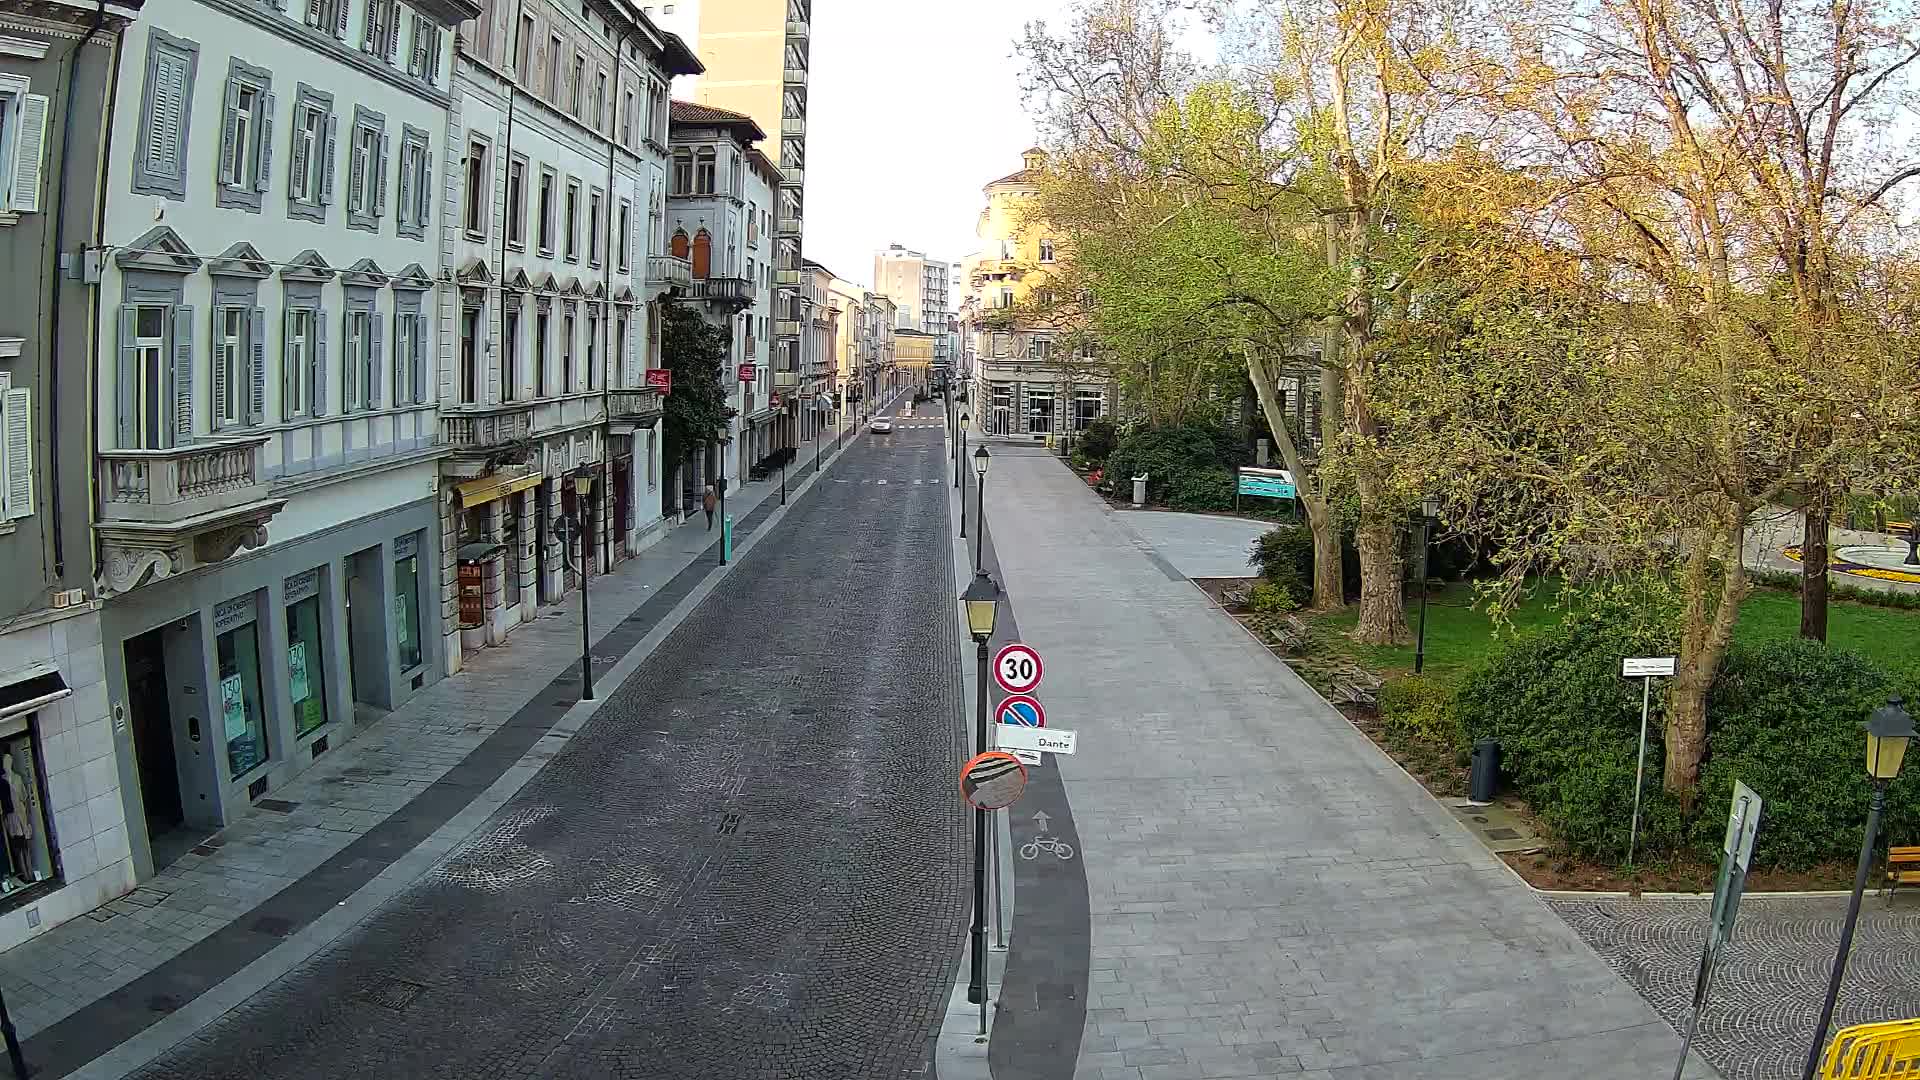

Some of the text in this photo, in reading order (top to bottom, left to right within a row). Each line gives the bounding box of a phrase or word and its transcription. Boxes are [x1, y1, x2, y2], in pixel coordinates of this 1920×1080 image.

[1005, 658, 1033, 680] 30
[222, 677, 240, 699] 130
[1038, 738, 1070, 749] Dante
